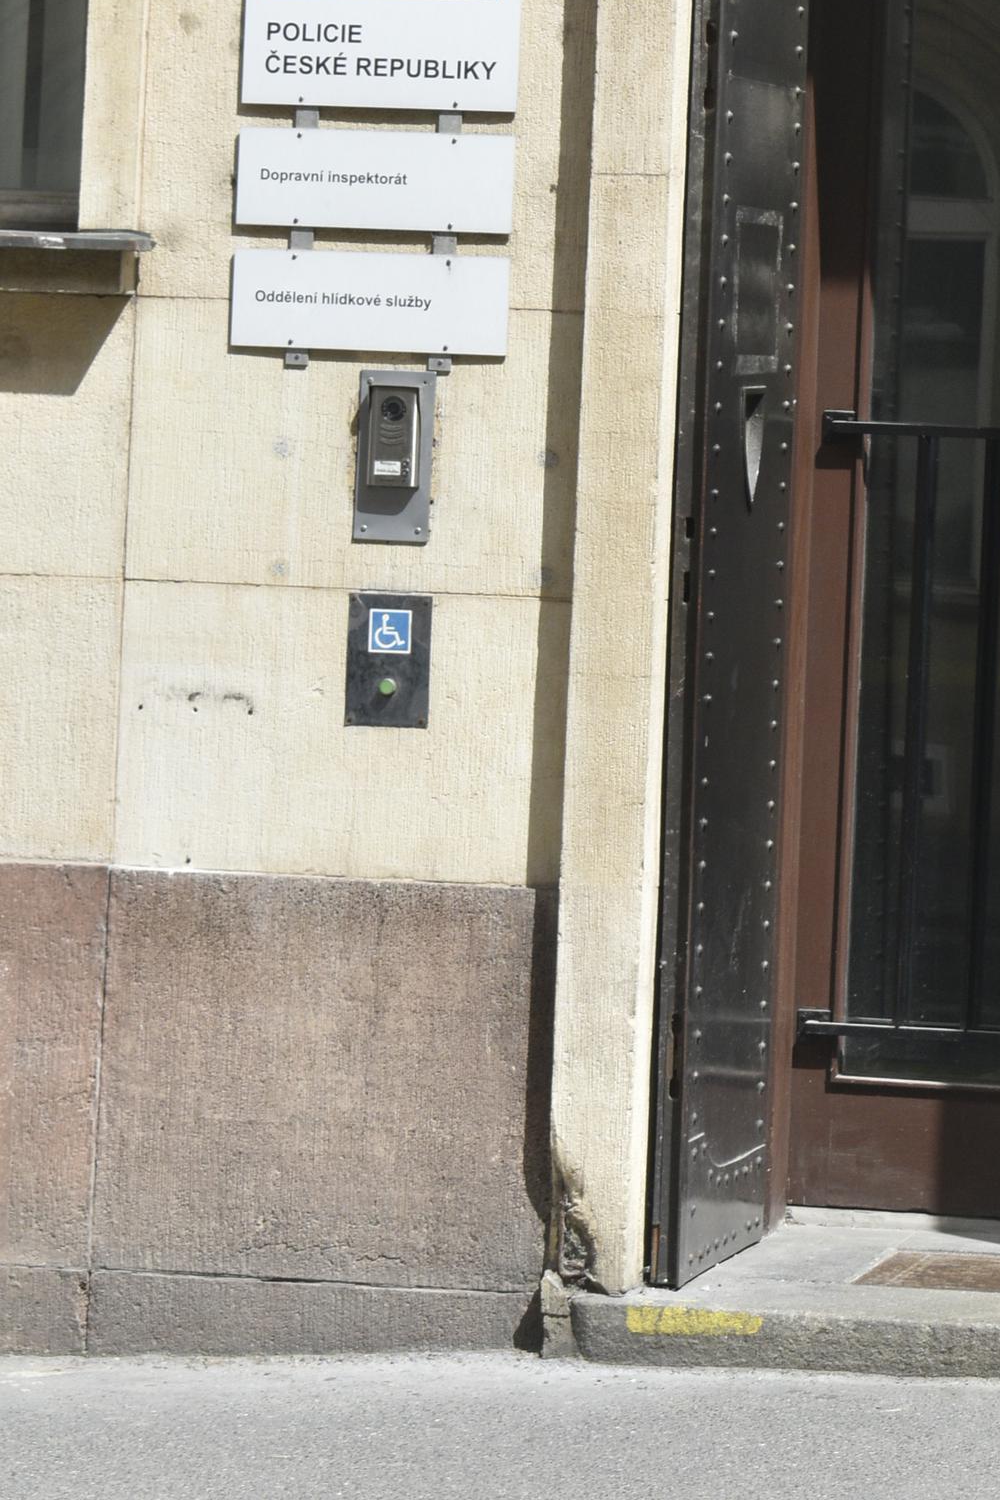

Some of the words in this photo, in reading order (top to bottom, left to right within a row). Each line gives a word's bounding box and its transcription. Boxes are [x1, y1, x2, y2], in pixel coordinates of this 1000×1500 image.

[267, 22, 362, 43] POLICIE
[265, 50, 347, 75] ČESKÉ
[356, 57, 497, 80] REPUBLIKY
[260, 168, 324, 184] Dopravní
[327, 171, 408, 186] inspektorát
[255, 290, 318, 304] Oddělení
[322, 292, 381, 306] hlídkové
[386, 295, 432, 311] služby
